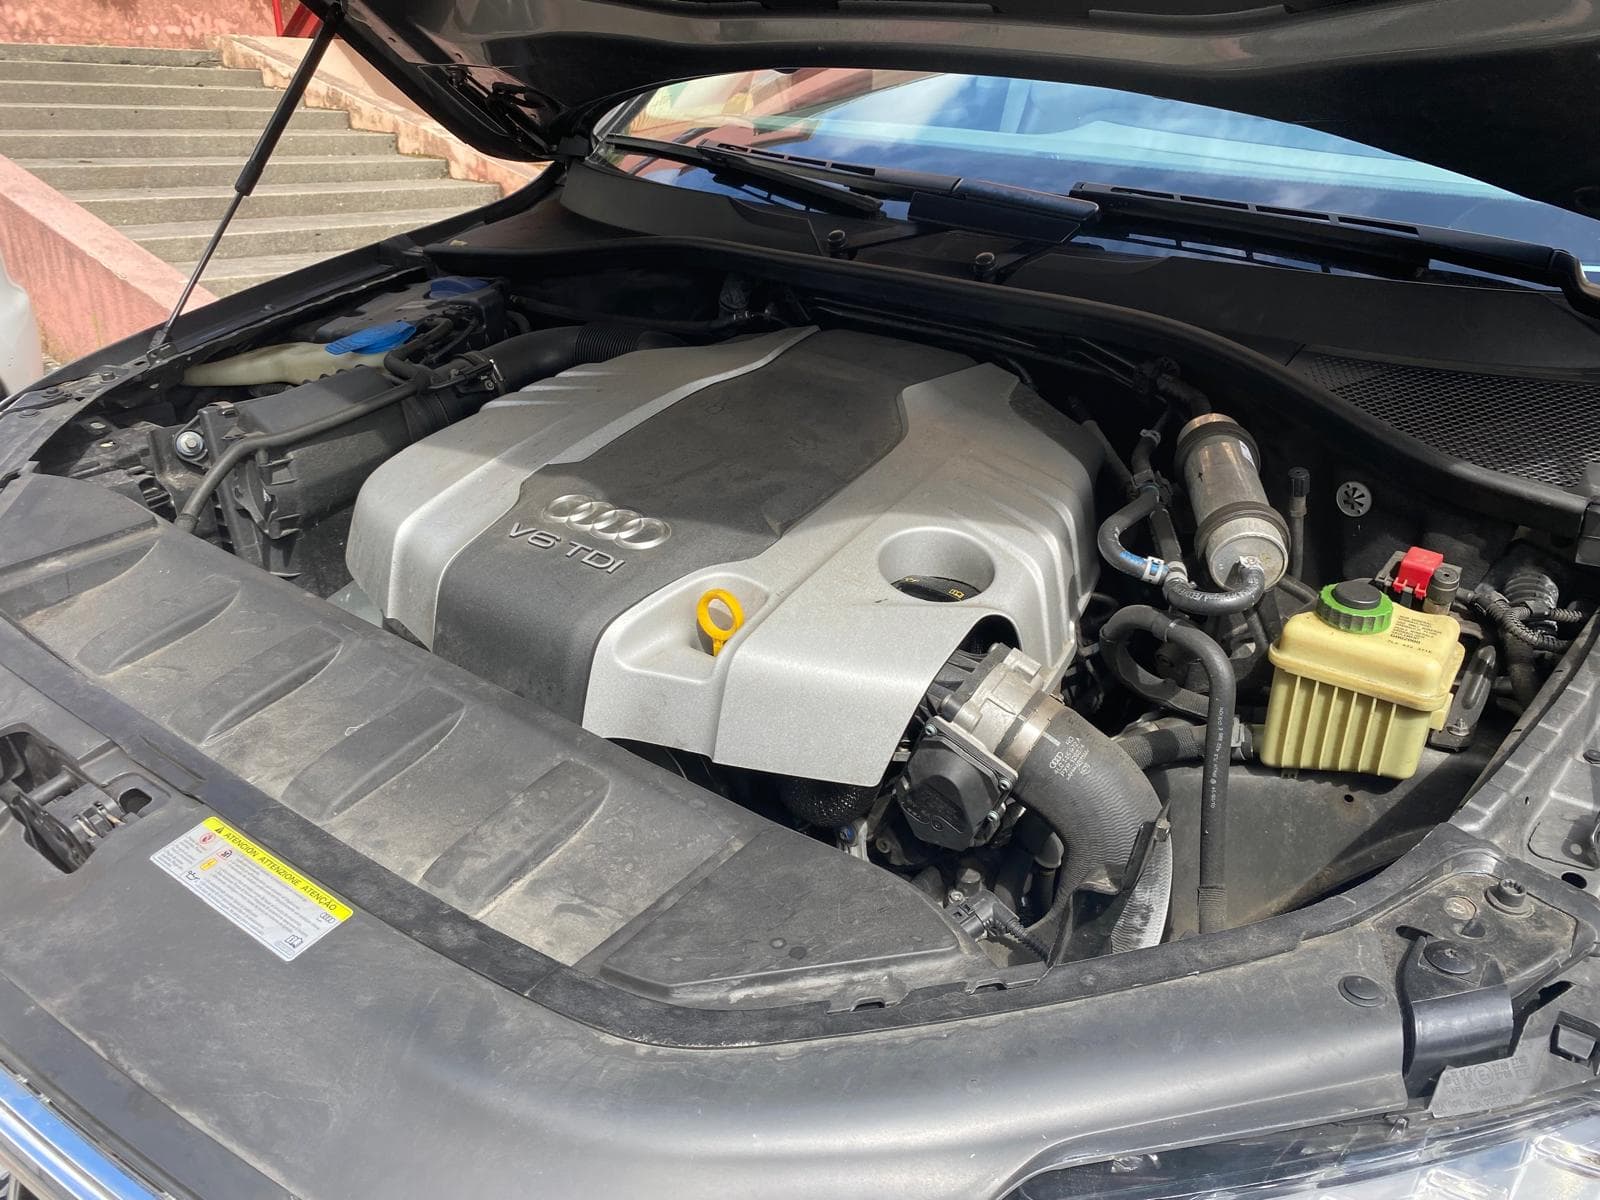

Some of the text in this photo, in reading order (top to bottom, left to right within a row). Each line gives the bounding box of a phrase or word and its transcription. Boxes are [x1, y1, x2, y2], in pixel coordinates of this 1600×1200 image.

[509, 522, 626, 575] V6 TDI
[260, 856, 302, 886] ATTENZIONE
[301, 885, 337, 911] ATENÇÃO
